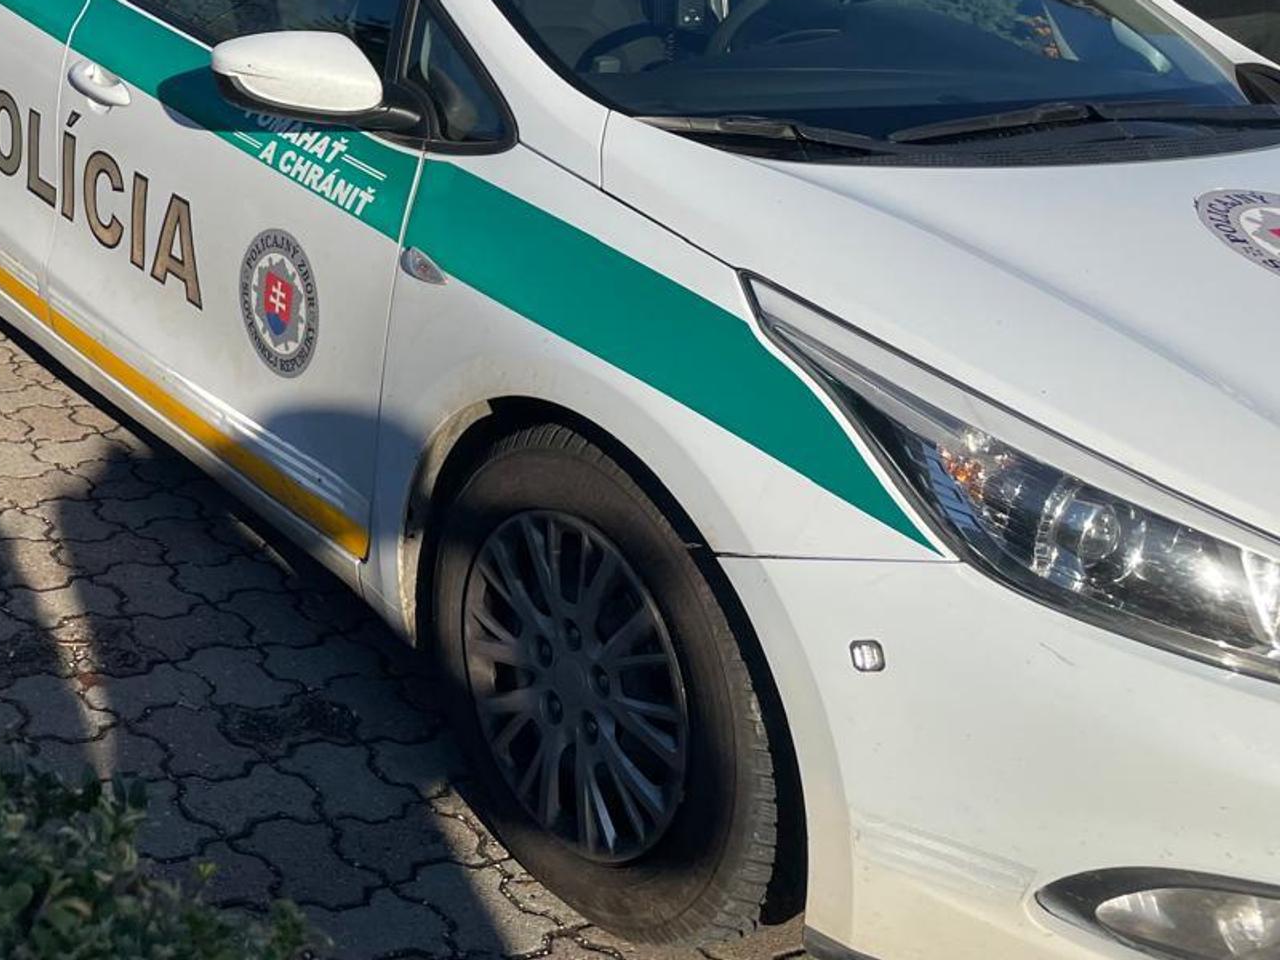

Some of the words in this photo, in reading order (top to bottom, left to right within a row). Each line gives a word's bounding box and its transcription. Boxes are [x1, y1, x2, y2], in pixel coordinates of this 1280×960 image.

[258, 141, 278, 165] A
[278, 150, 376, 216] CHRÁNIŤ
[297, 259, 316, 307] ZBOR
